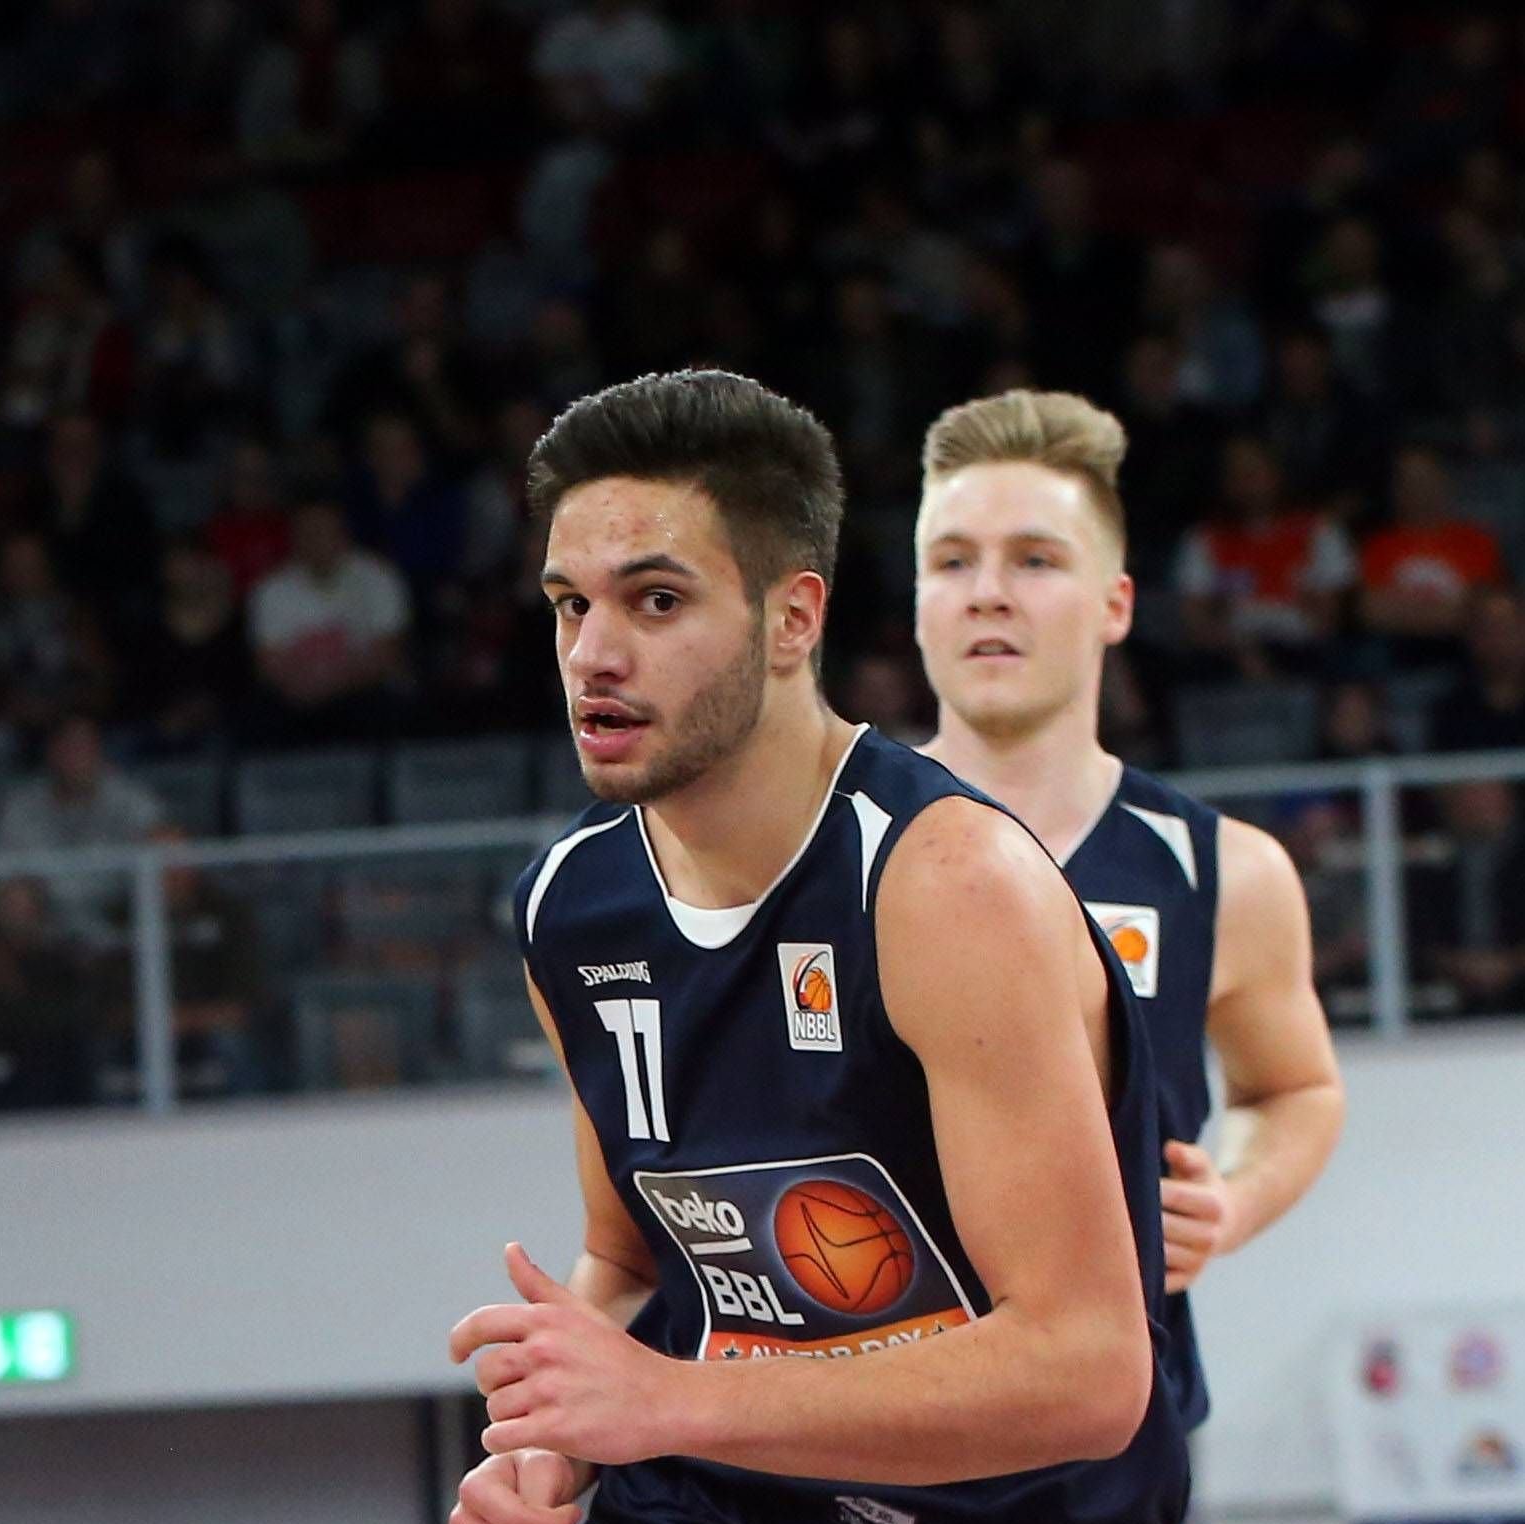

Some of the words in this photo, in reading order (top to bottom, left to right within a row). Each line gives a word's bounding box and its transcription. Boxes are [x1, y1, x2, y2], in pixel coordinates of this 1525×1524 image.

[577, 960, 652, 987] SPALDING
[794, 1010, 836, 1042] NBBL
[592, 998, 670, 1141] 11
[651, 1189, 746, 1237] beko
[699, 1263, 806, 1326] BBL
